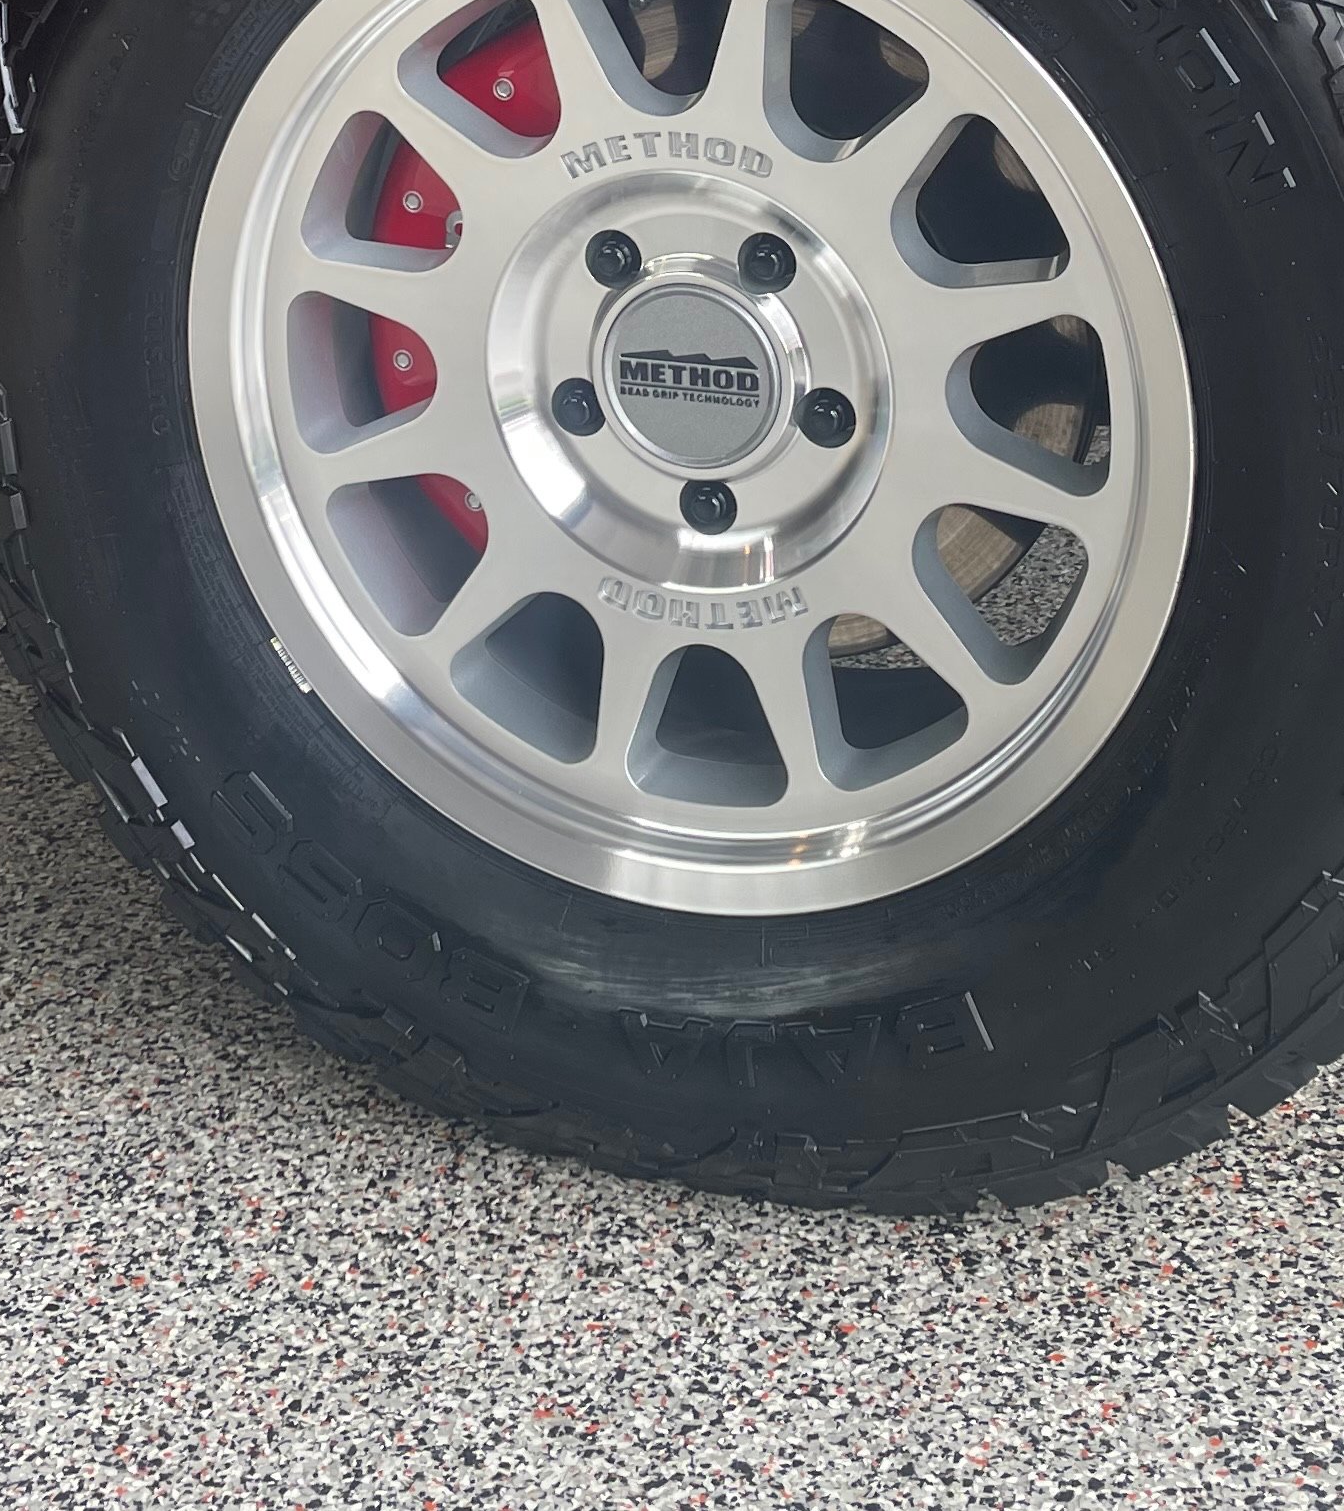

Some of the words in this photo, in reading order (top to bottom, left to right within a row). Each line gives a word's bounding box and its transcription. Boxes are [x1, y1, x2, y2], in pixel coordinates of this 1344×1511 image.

[560, 131, 774, 179] METHOD
[619, 360, 760, 392] METHOD
[619, 386, 649, 398] BEAD
[652, 390, 679, 401] GRIP
[682, 393, 760, 408] TECHNOLOGY
[597, 577, 809, 630] METHOD
[209, 769, 532, 1033] BOSS
[616, 990, 996, 1088] BAJA
